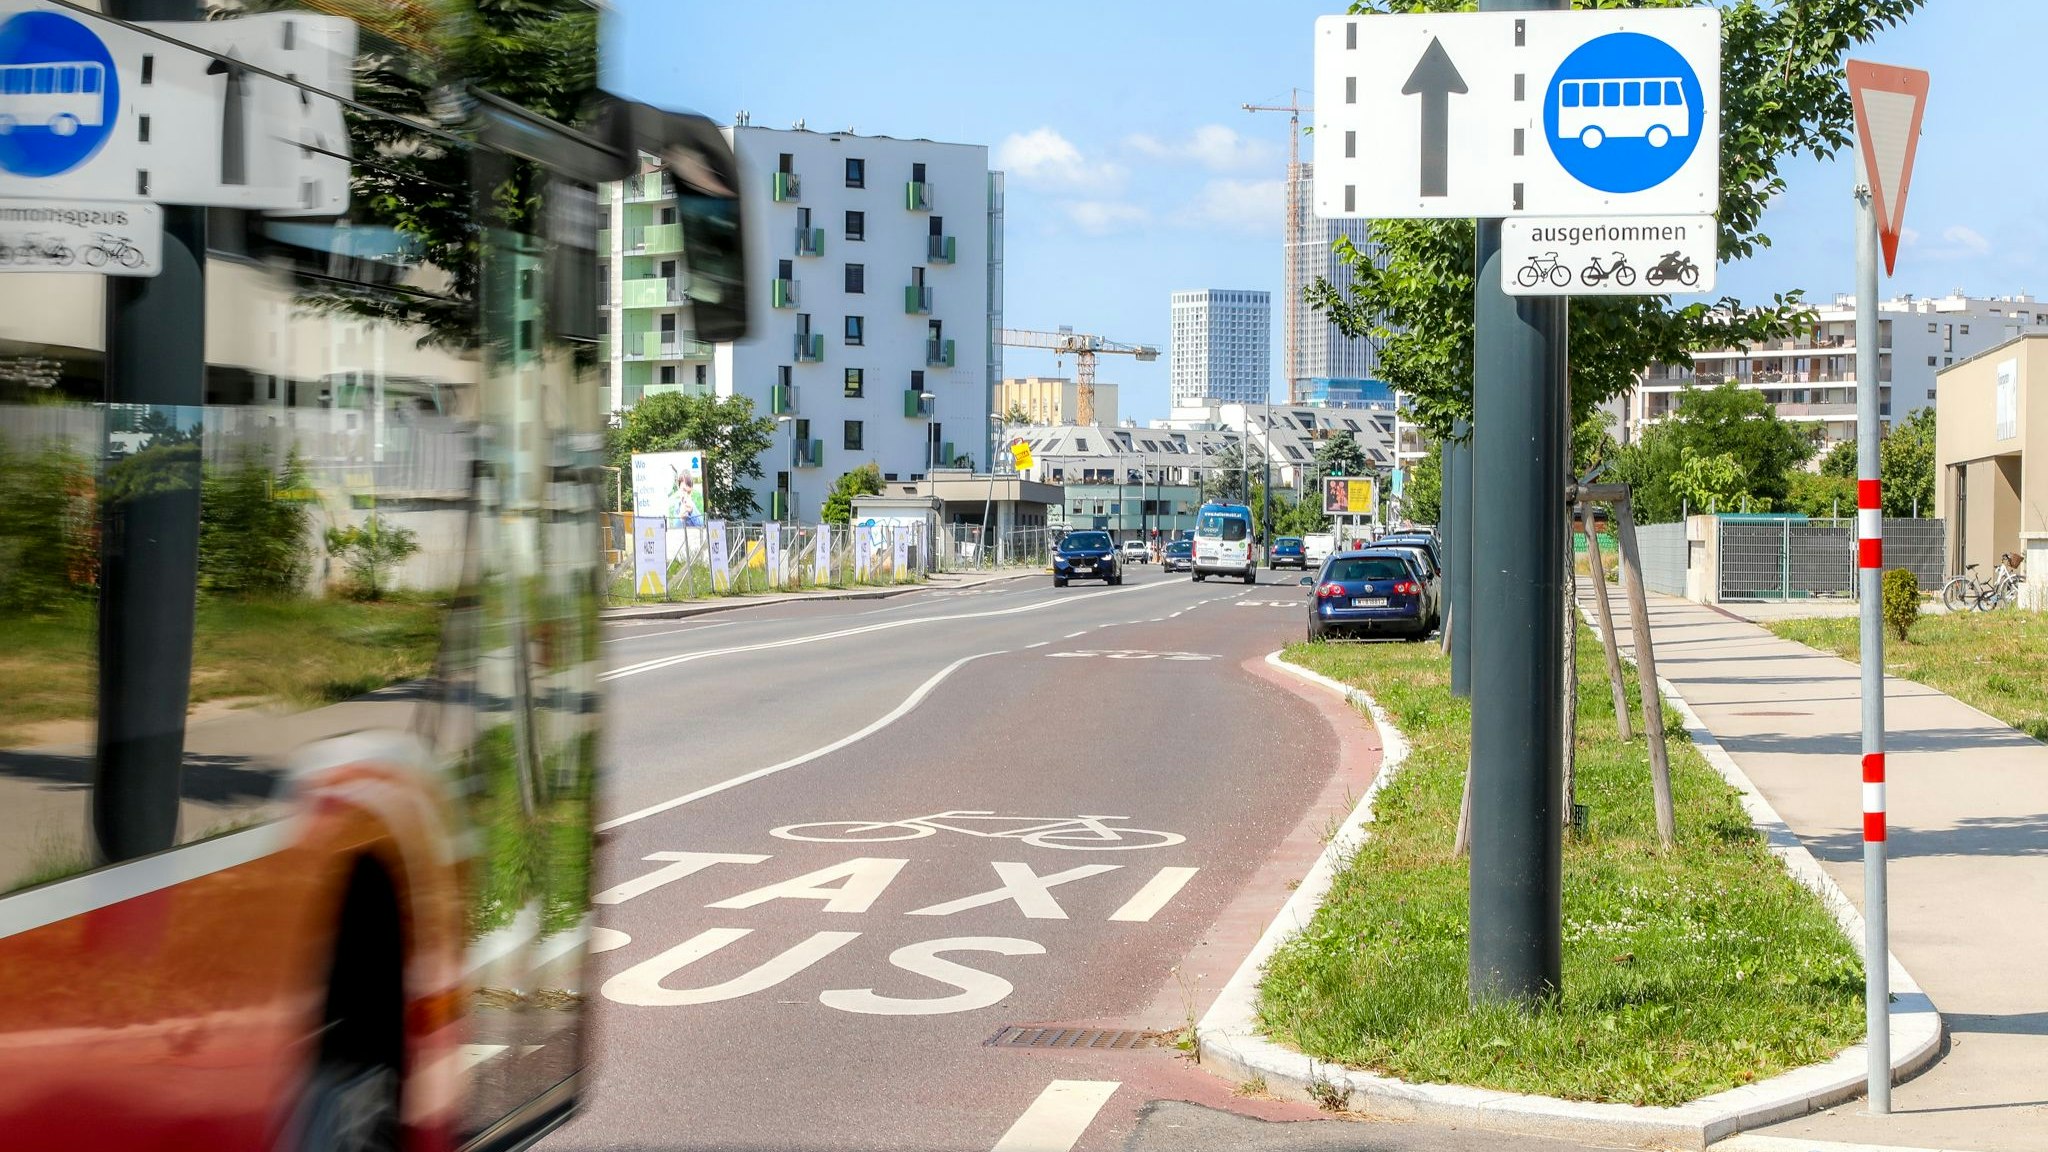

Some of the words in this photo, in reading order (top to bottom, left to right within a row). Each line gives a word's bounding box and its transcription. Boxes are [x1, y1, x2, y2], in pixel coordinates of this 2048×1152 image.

[1531, 226, 1687, 246] ausgenommen
[634, 460, 646, 469] Wo
[591, 850, 1200, 923] TAXI
[590, 926, 1047, 1016] US
